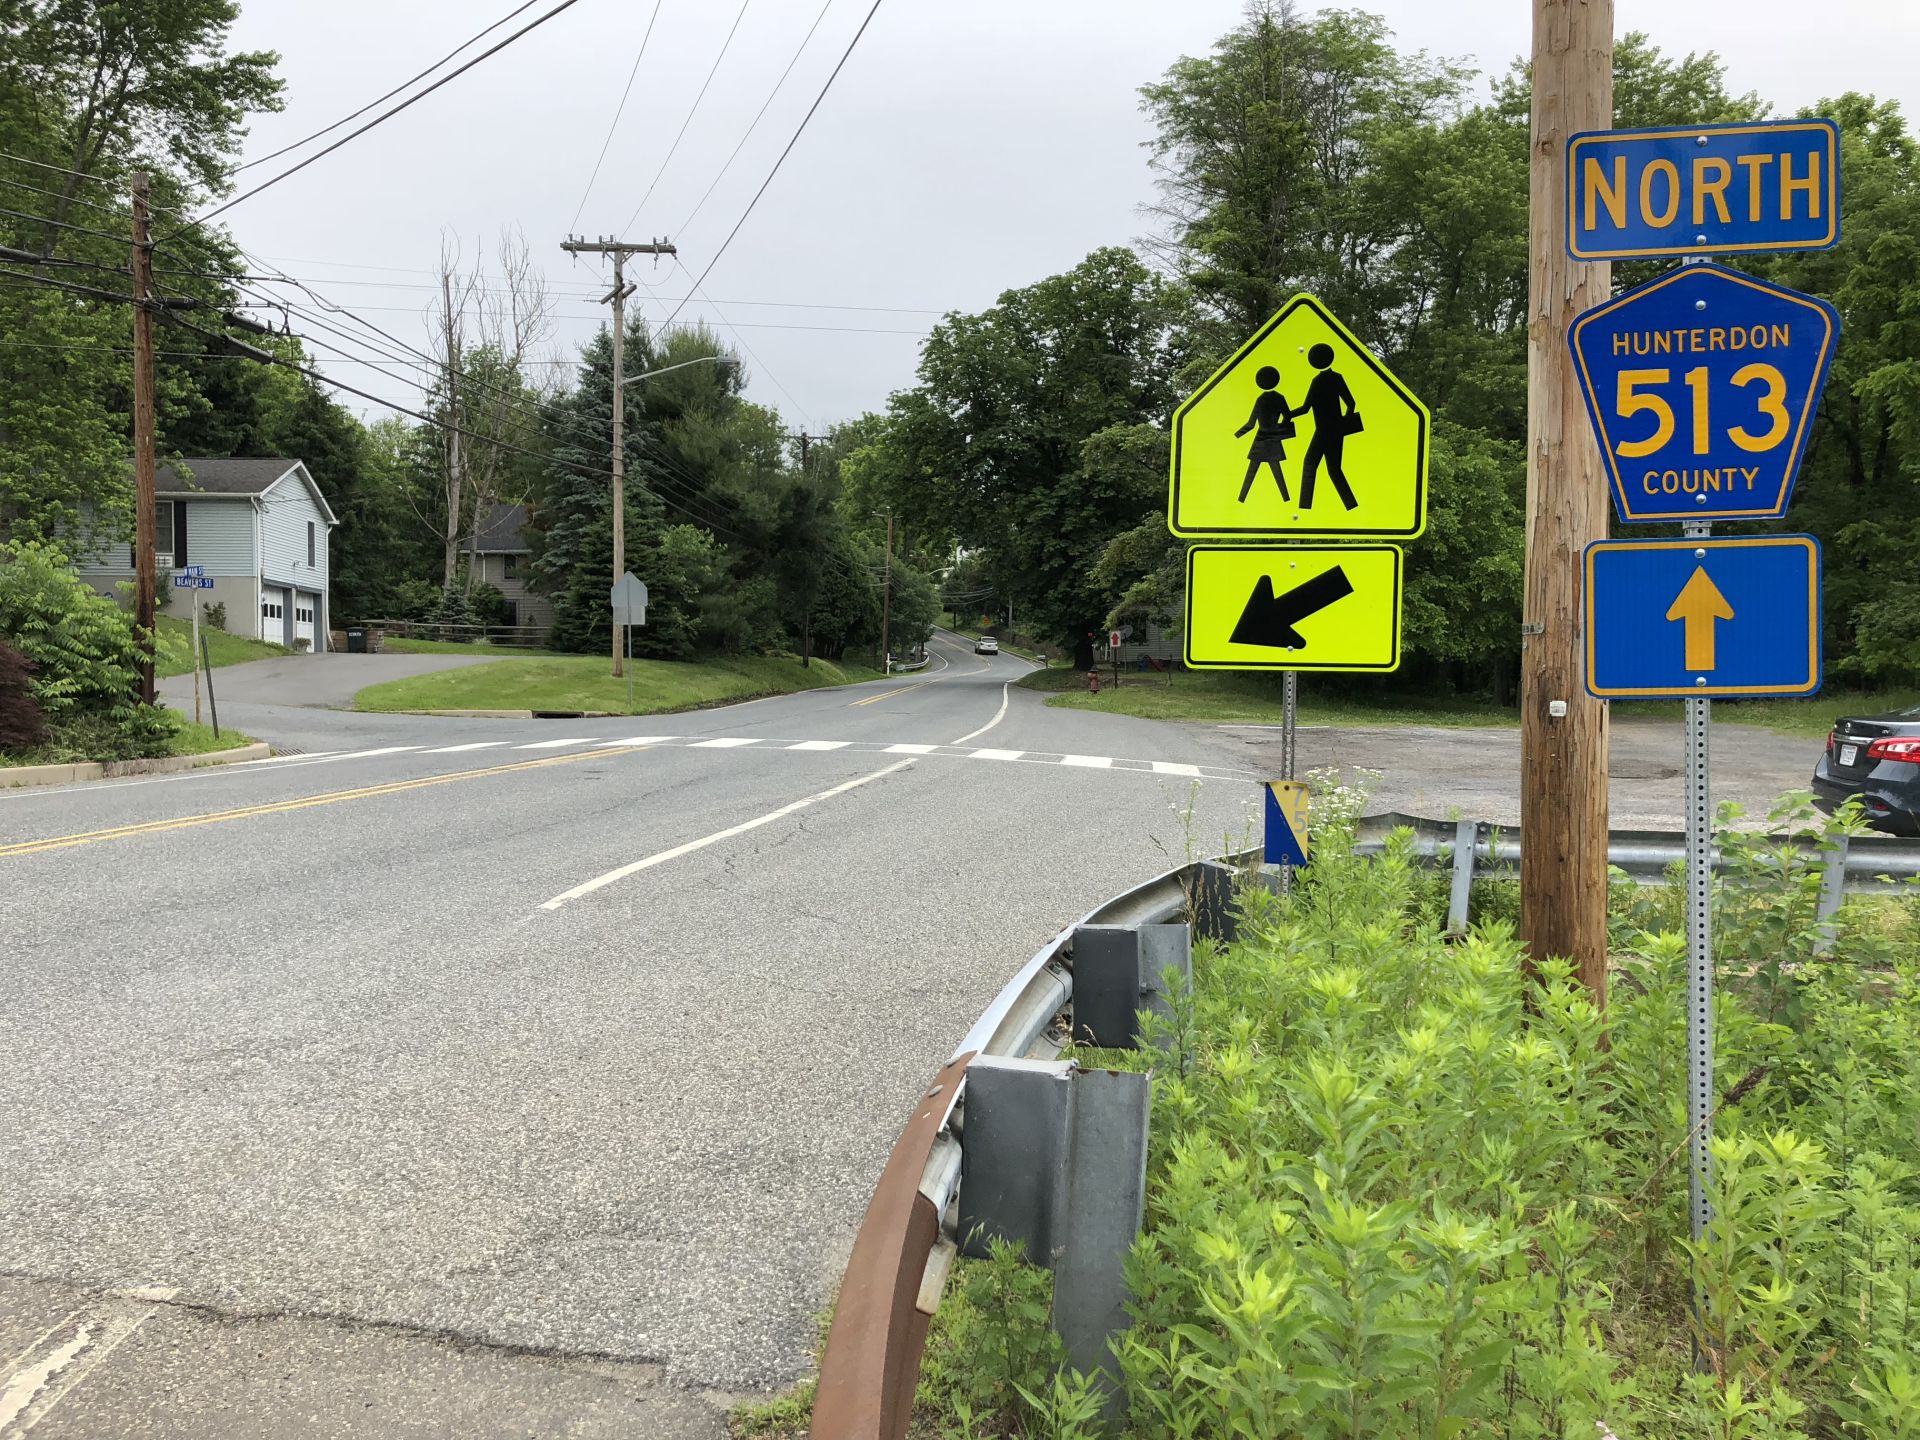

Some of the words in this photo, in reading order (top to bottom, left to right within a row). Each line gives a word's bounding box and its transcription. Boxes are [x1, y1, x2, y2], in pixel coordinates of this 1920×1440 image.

[1584, 151, 1820, 231] NORTH
[1612, 323, 1790, 356] HUNTERDON
[1615, 362, 1790, 458] 513
[1643, 466, 1760, 495] COUNTY
[204, 578, 212, 587] ST
